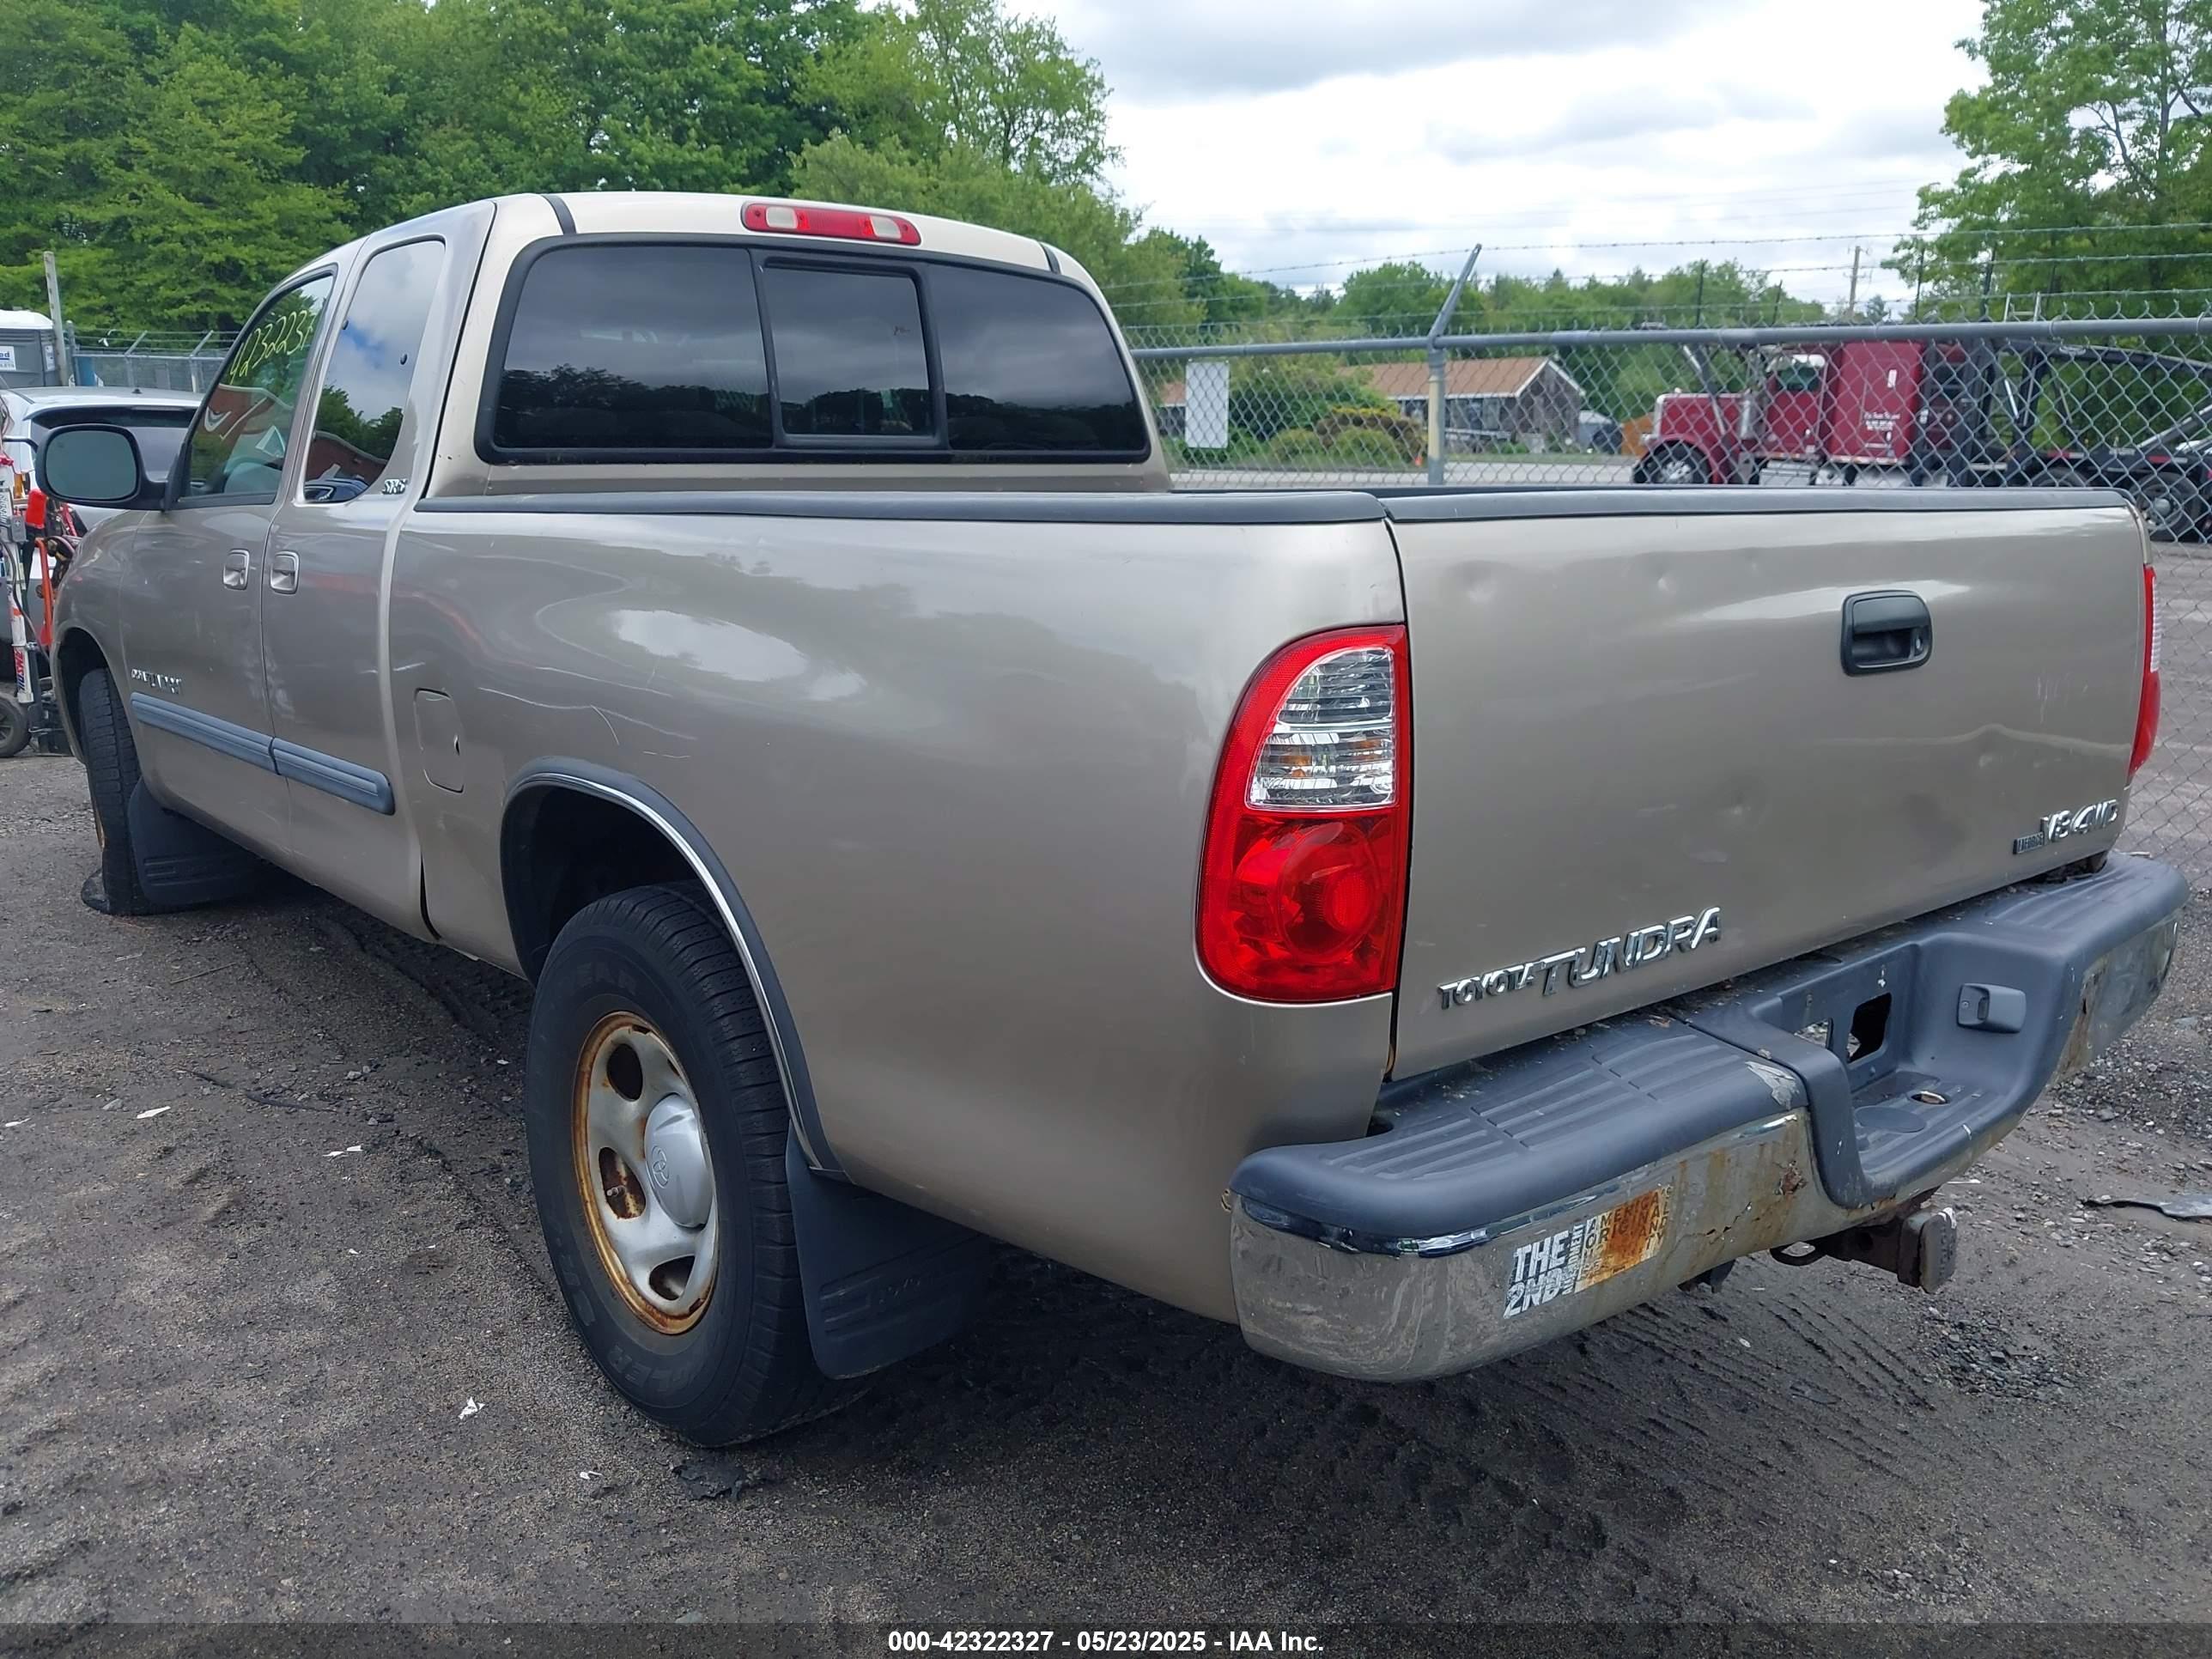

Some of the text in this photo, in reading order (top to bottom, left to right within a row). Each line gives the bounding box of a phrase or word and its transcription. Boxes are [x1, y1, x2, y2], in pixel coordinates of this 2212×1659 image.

[1437, 905, 1723, 1010] TOYOTA TUNDRA
[1513, 1230, 1570, 1283] THE
[1503, 1267, 1563, 1320] 2ND
